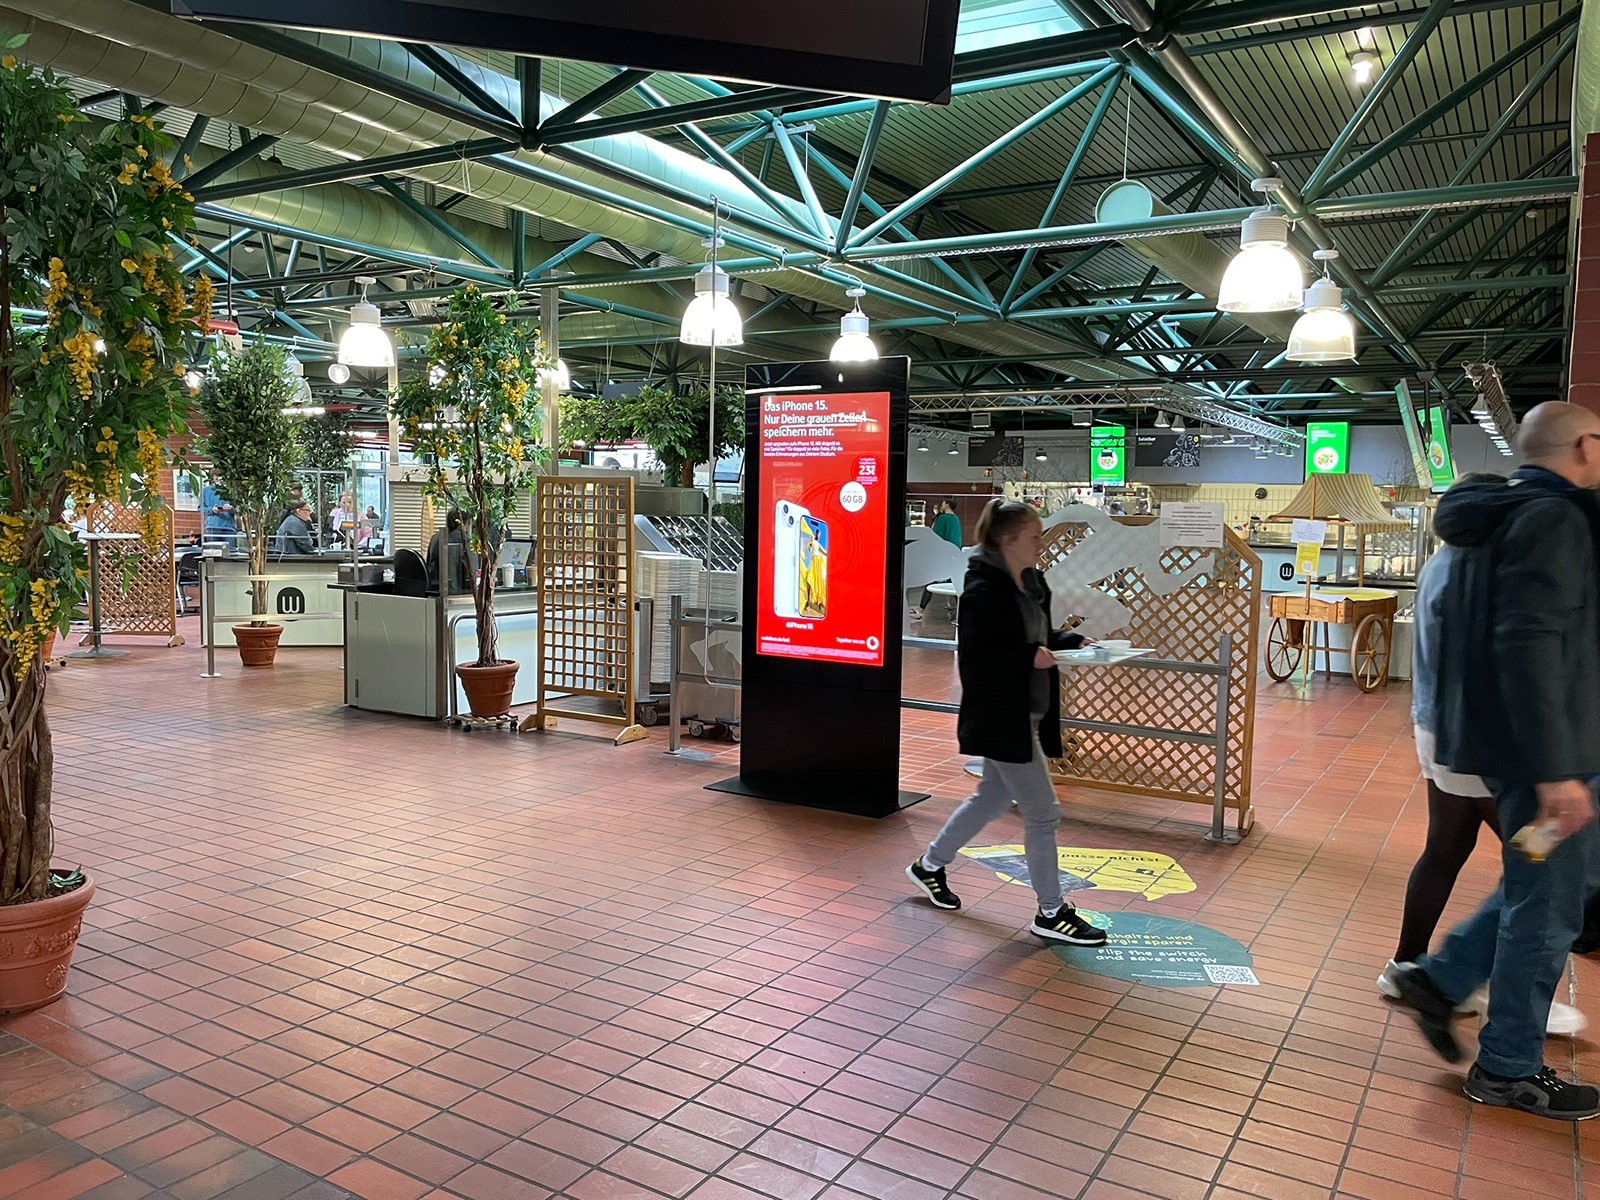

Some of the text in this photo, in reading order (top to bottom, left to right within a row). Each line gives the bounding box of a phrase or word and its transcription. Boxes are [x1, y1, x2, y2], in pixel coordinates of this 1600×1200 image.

[764, 400, 828, 411] Das iPhone 15.
[764, 414, 780, 424] Nur
[781, 413, 805, 424] Deine
[807, 414, 836, 426] grauen
[763, 426, 835, 439] speichern mehr.
[842, 495, 863, 503] 60 GB
